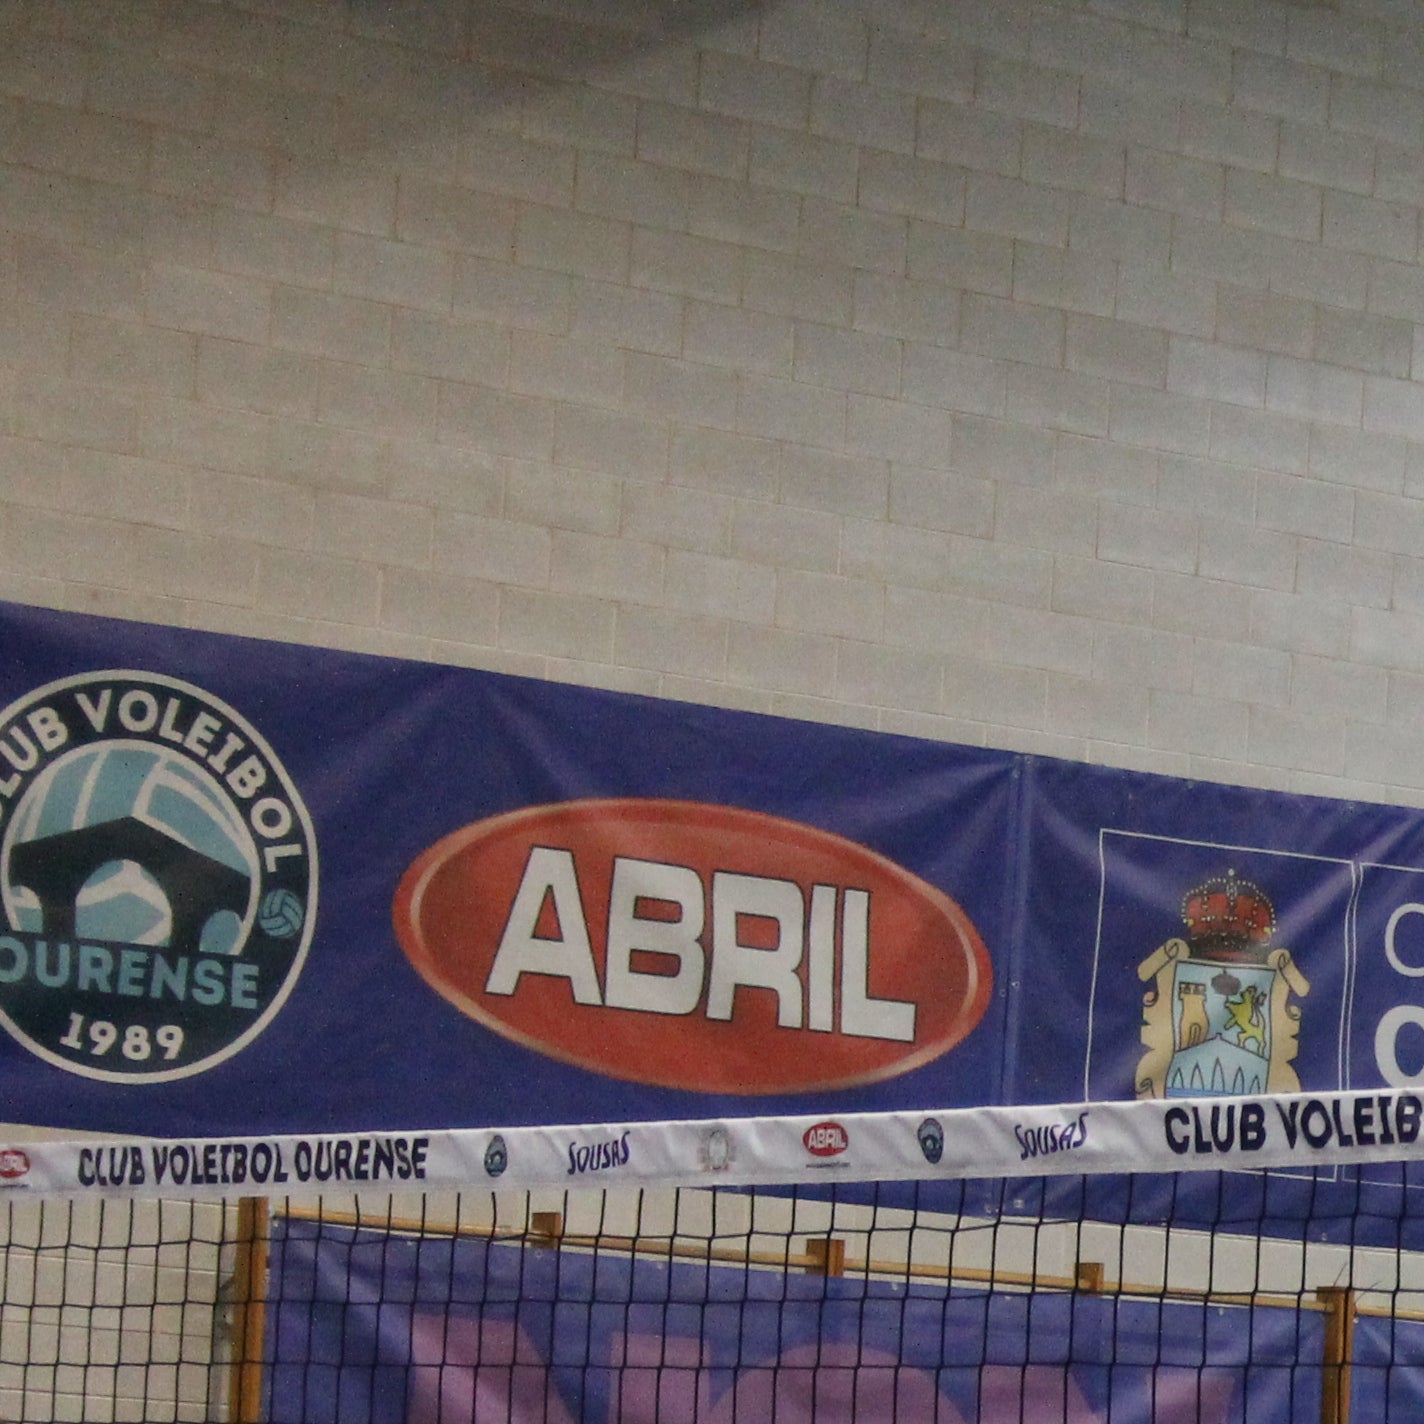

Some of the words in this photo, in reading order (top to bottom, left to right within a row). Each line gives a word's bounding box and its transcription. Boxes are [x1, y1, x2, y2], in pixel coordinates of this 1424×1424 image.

[75, 688, 303, 873] VOLEIBOL
[484, 844, 917, 1043] ABRIL
[0, 940, 260, 1009] OURENSE
[59, 1012, 185, 1061] 1989
[566, 1130, 631, 1175] SOUSAS
[808, 1128, 848, 1150] ABRIL
[1013, 1111, 1090, 1160] SOUSAS
[1164, 1103, 1267, 1154] CLUB
[78, 1147, 146, 1187] CLUB
[152, 1142, 288, 1185] VOLEIBOL
[294, 1138, 430, 1182] OURENSE
